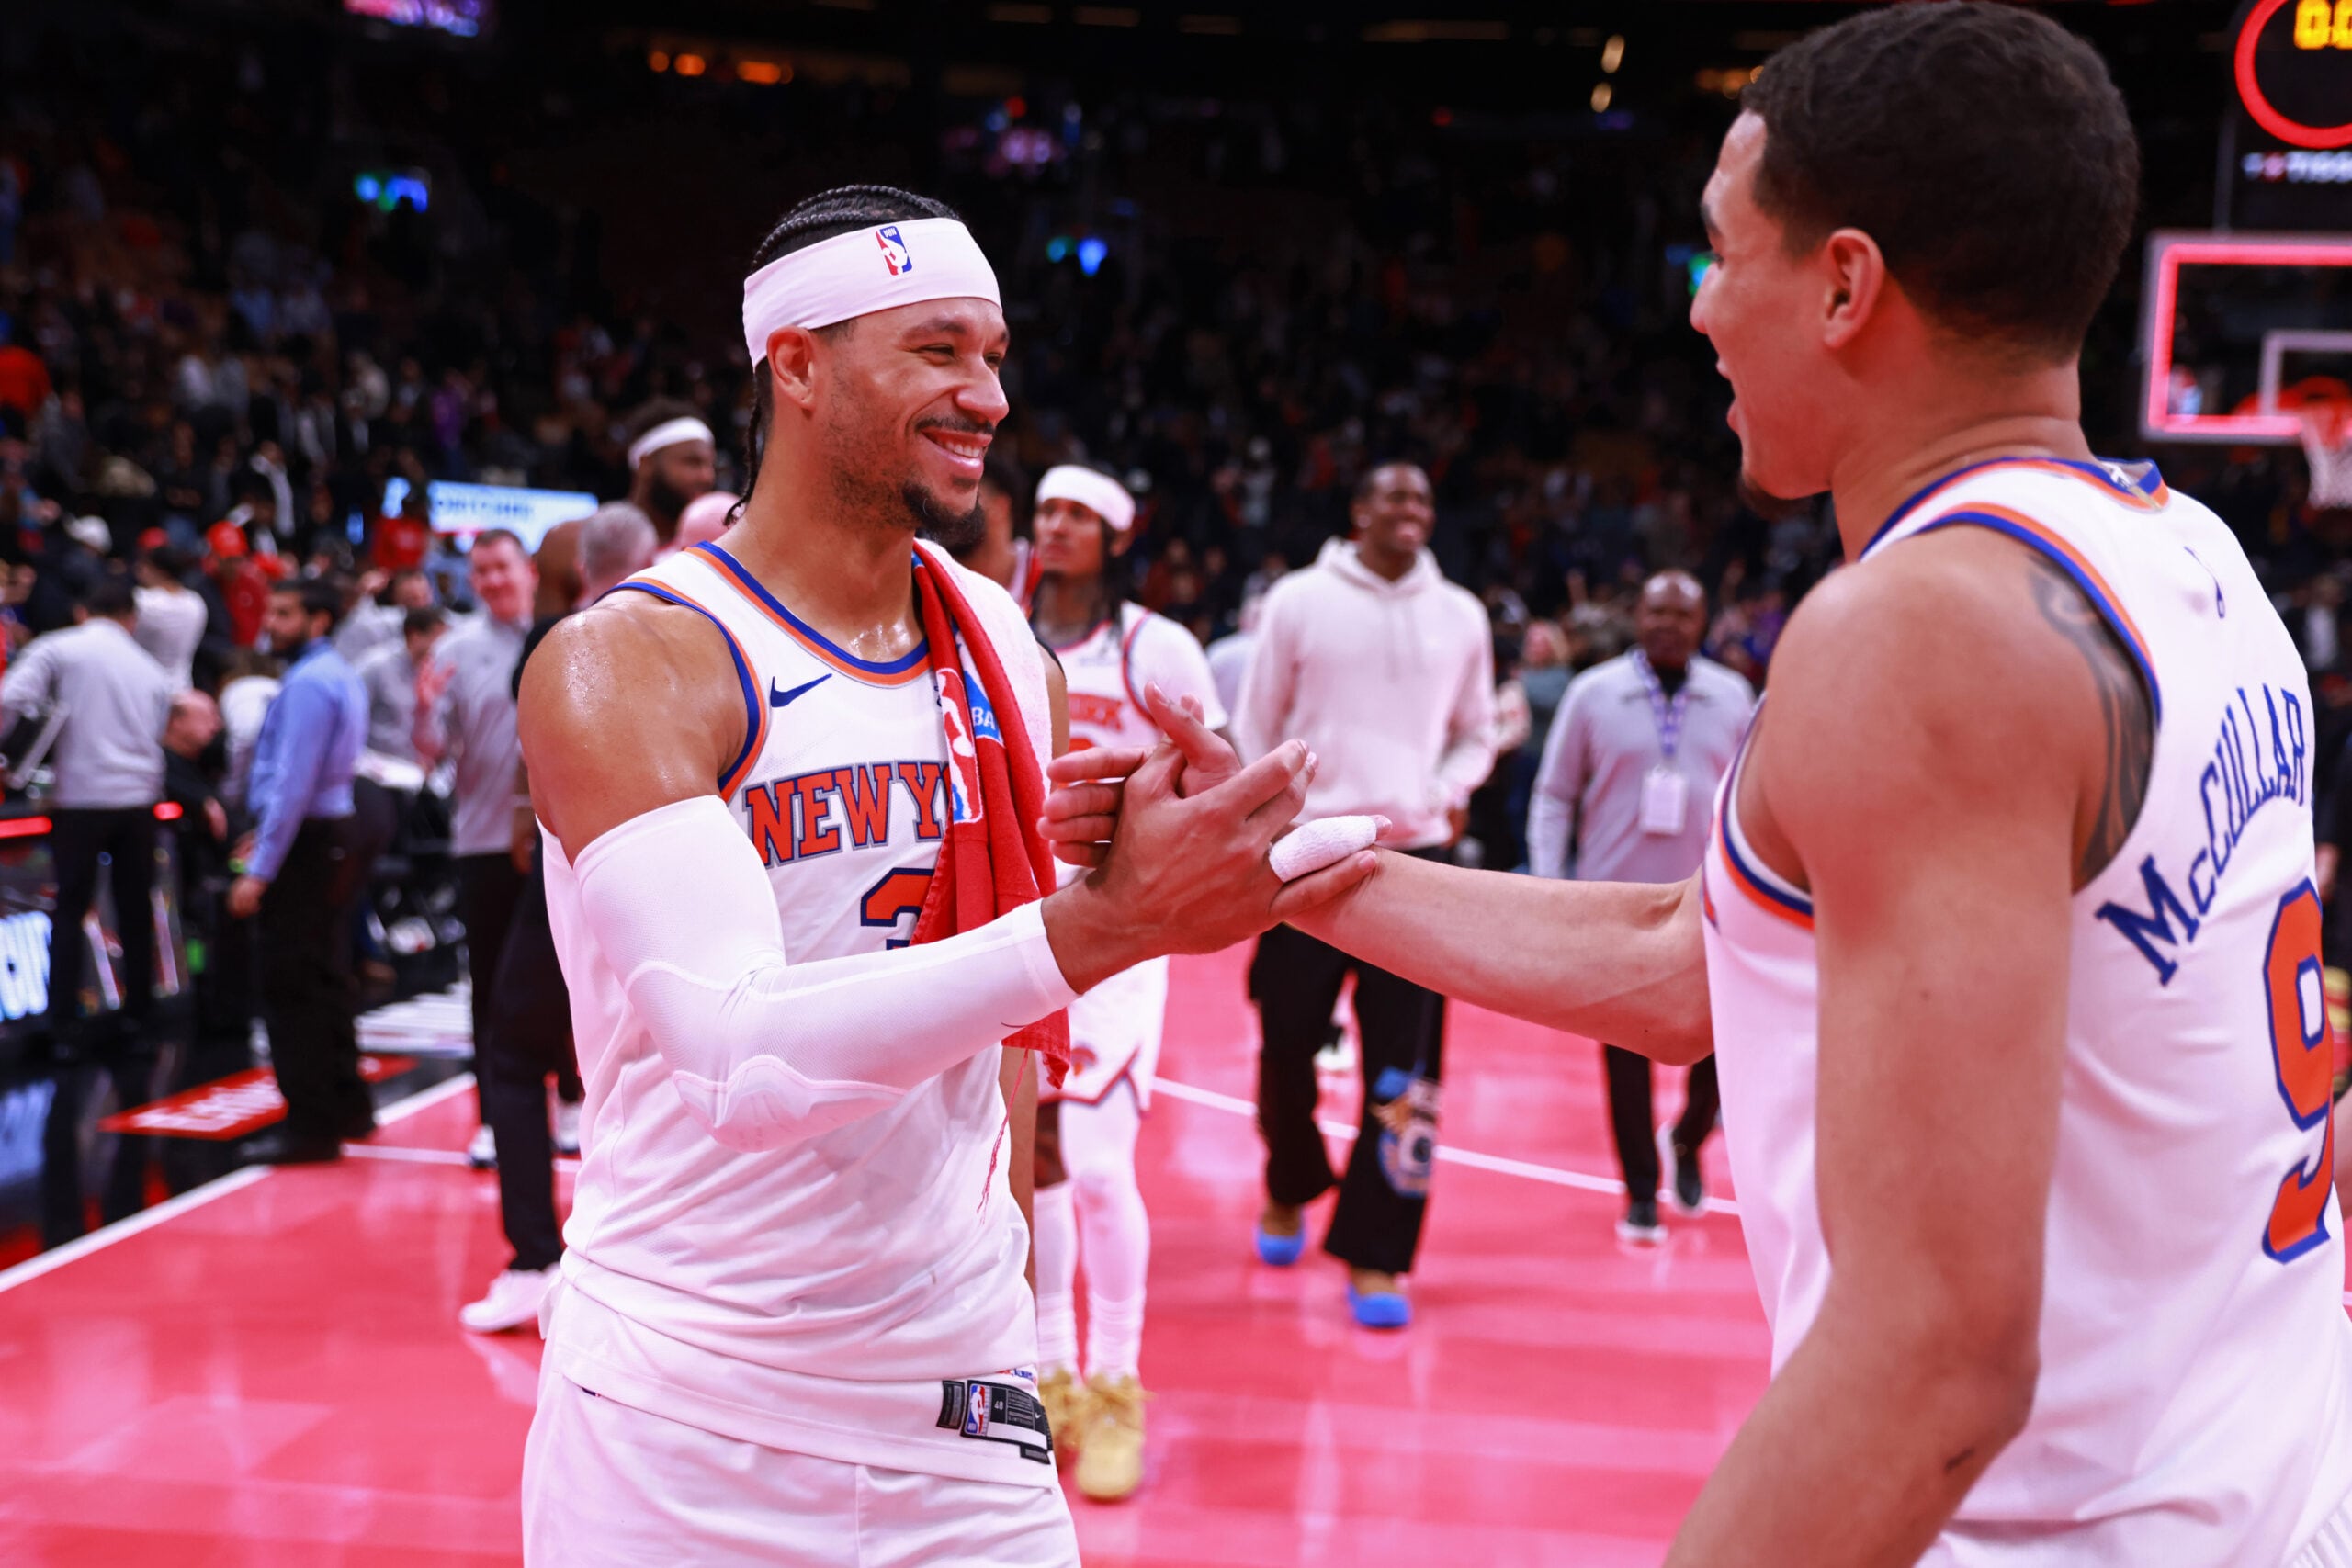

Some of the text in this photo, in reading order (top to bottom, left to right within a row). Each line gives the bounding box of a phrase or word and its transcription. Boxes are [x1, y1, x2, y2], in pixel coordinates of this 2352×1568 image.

[742, 762, 893, 868] NEW
[971, 706, 996, 731] BA
[2095, 682, 2305, 987] McCULLAR
[2262, 876, 2335, 1264] 9
